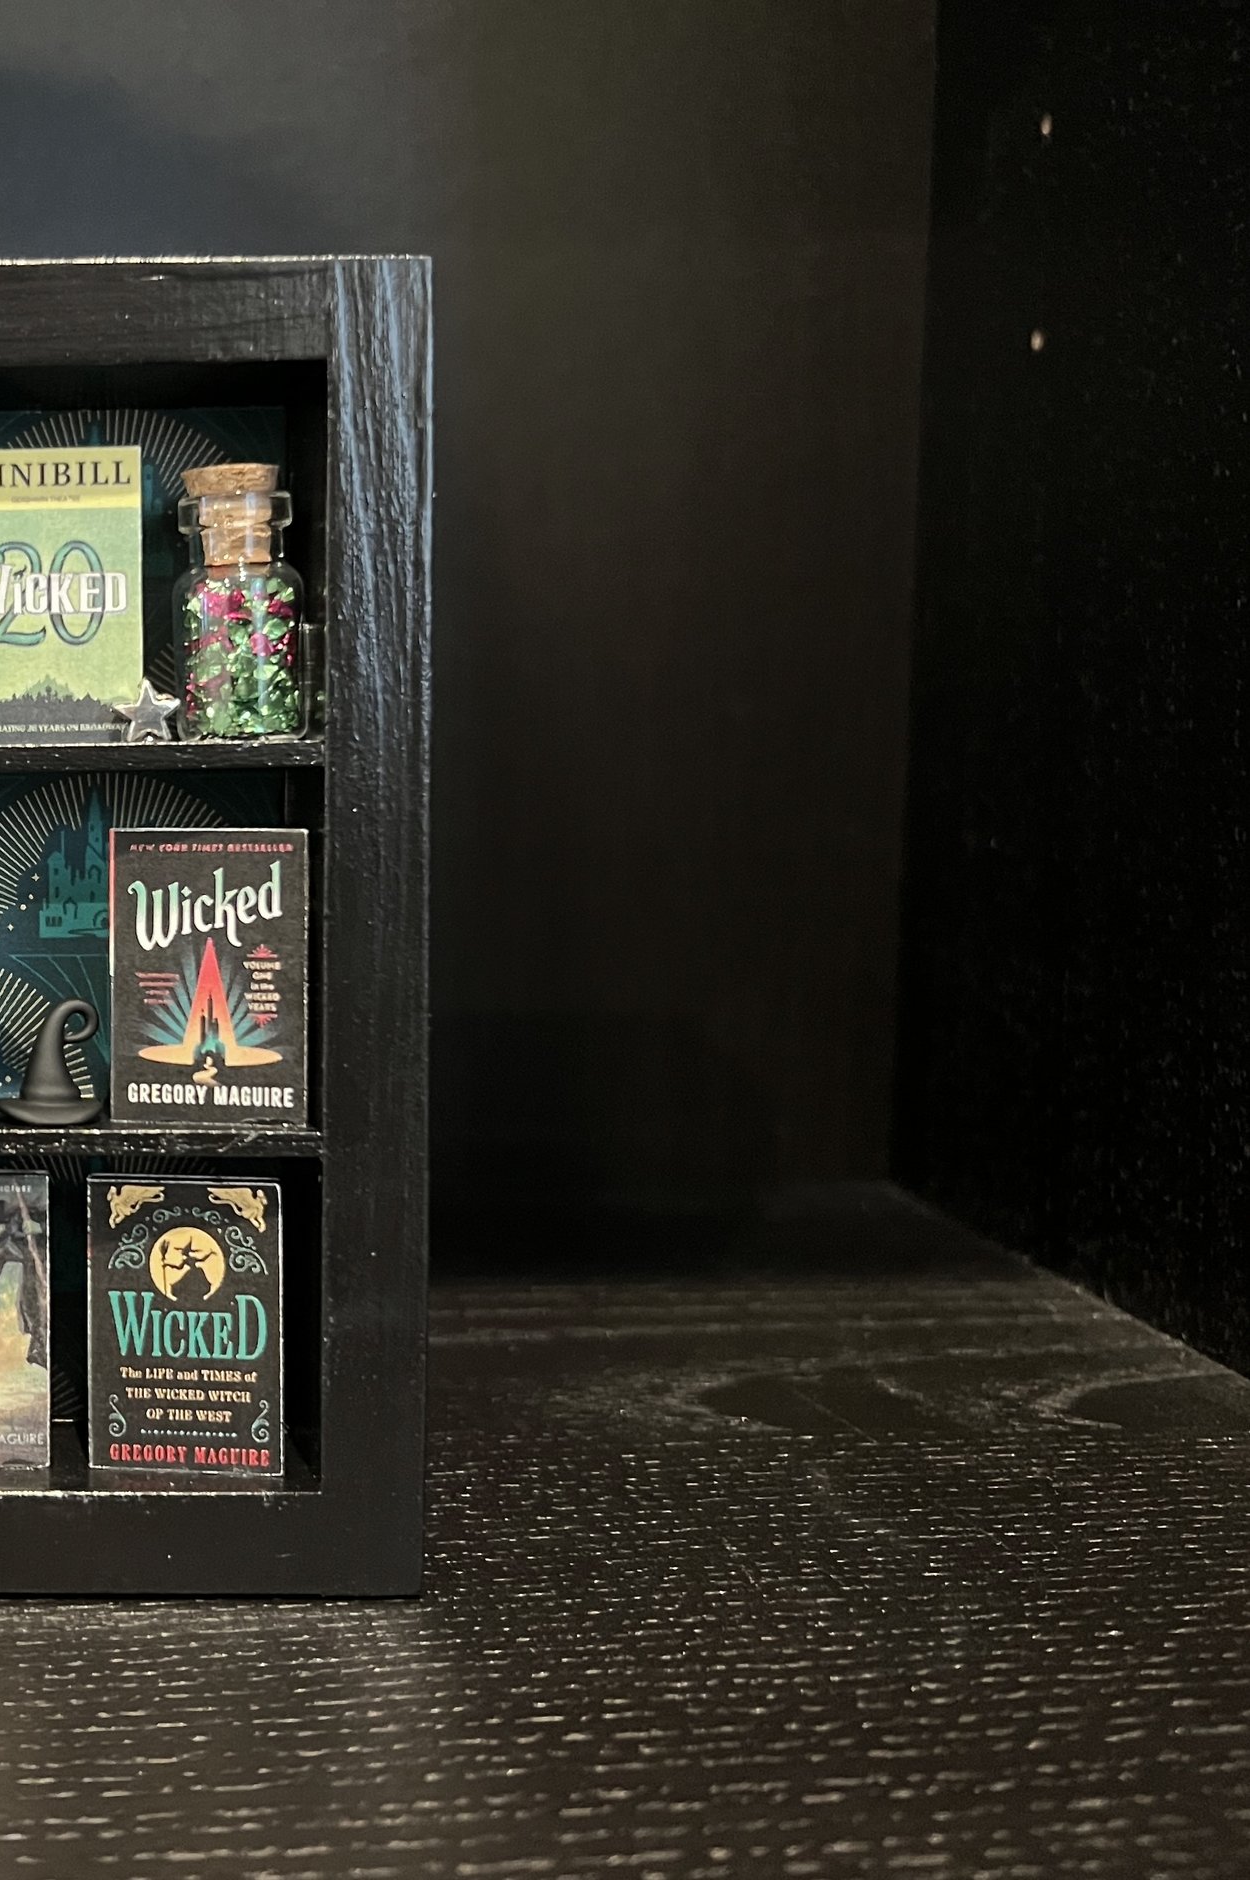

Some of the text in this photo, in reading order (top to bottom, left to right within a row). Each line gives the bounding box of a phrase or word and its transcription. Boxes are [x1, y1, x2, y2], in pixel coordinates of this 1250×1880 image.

[38, 723, 65, 733] YEARS
[66, 723, 79, 732] ON
[127, 861, 283, 951] Wicked
[243, 961, 281, 970] VOLUME
[248, 1002, 277, 1012] YEARS
[127, 1083, 294, 1108] GREGORY MAGUIRE
[108, 1290, 269, 1360] WICKED
[120, 1366, 258, 1383] The LIFE and TIMES of
[125, 1386, 252, 1403] THE WICKED WITCH
[146, 1408, 233, 1423] OF THE WEST
[109, 1443, 270, 1467] GREGORY MAGUIRE
